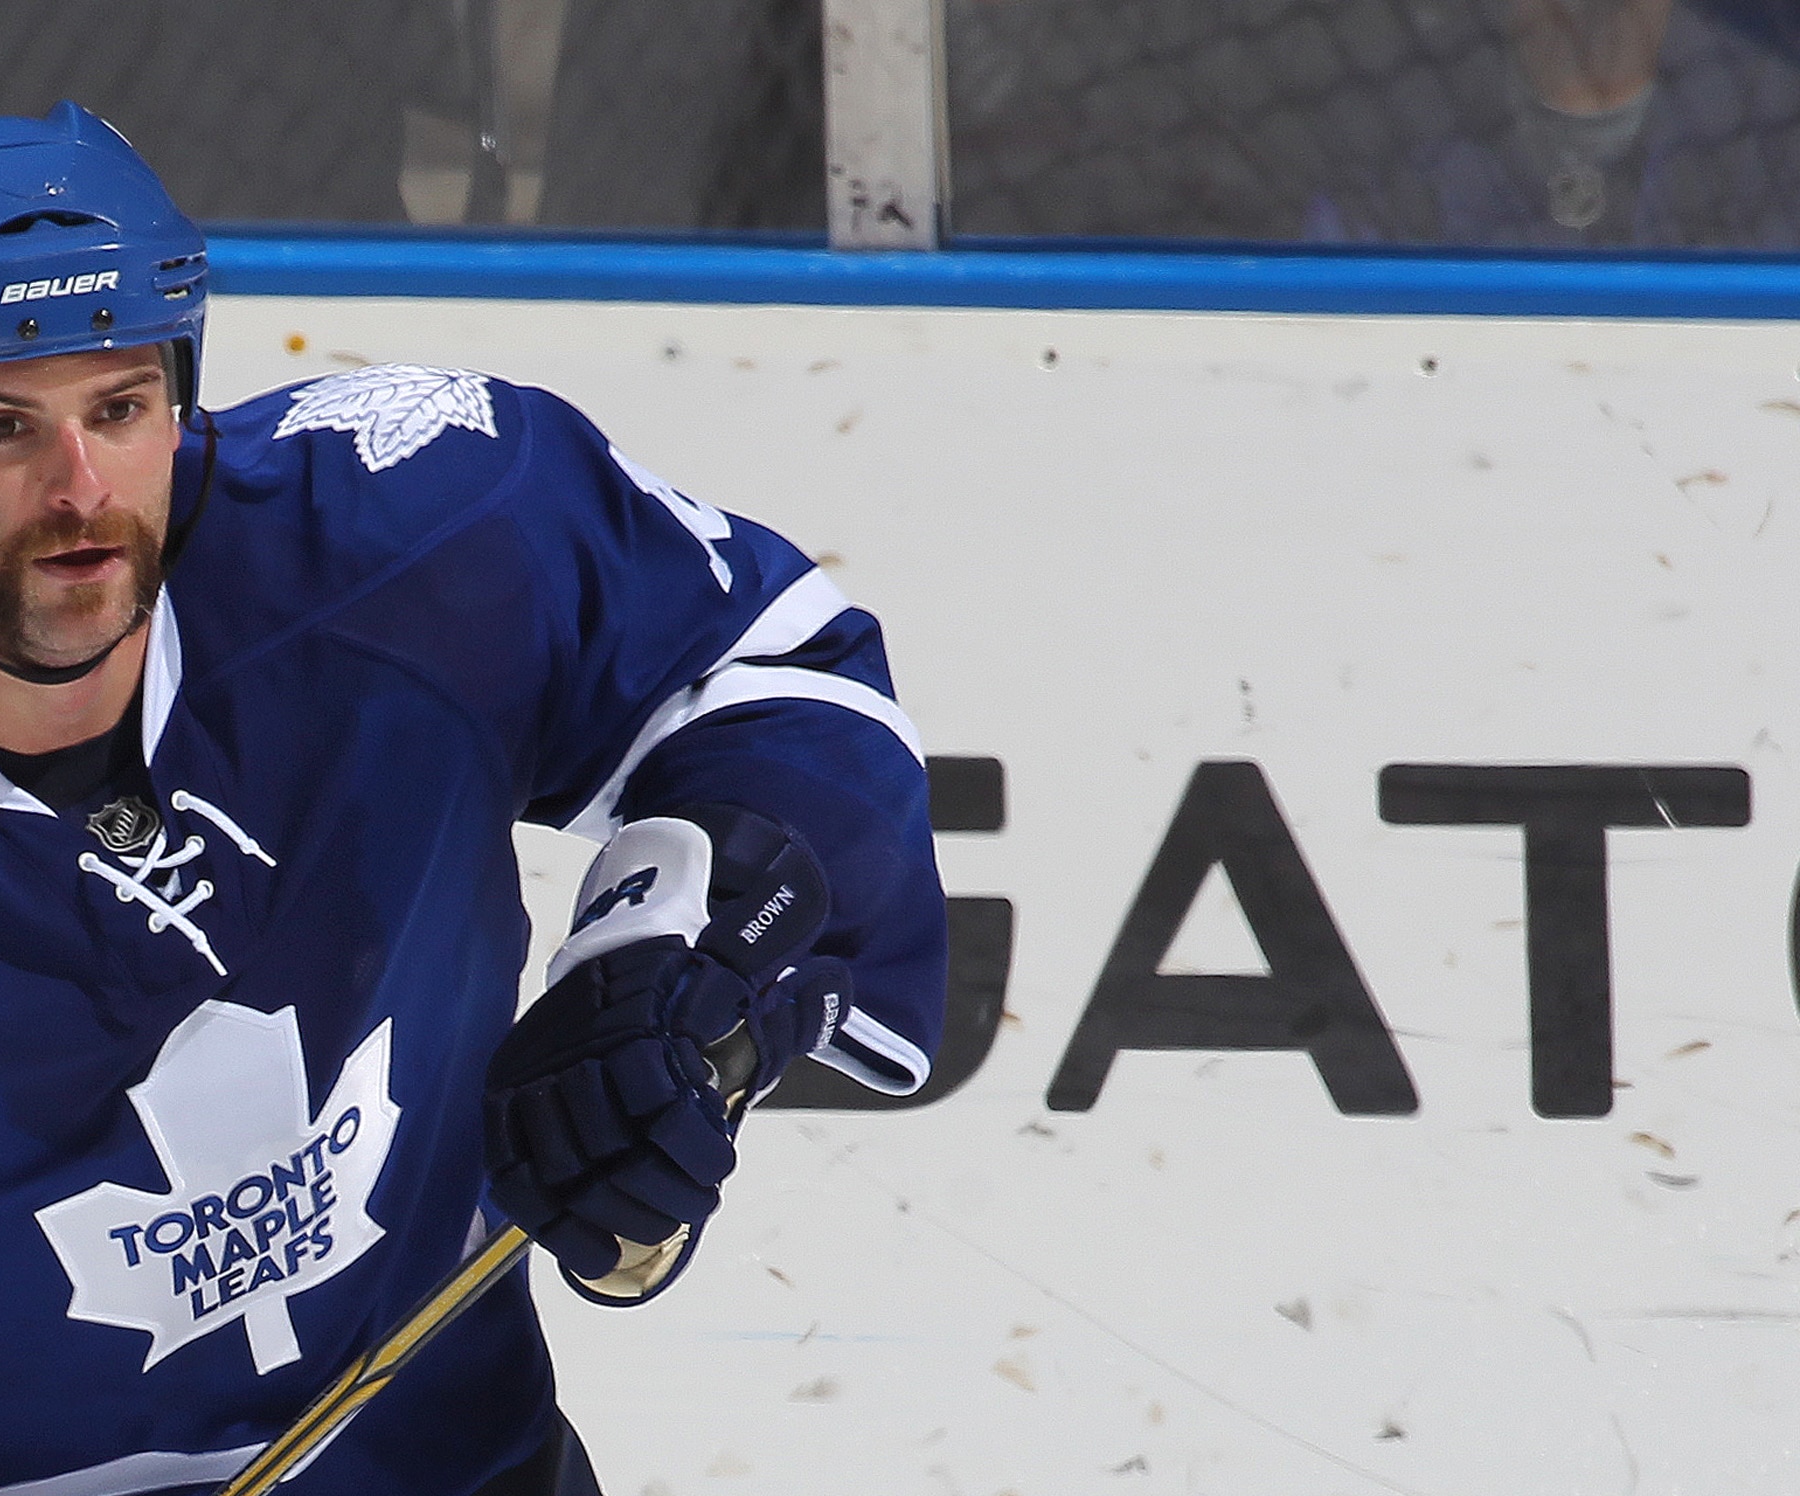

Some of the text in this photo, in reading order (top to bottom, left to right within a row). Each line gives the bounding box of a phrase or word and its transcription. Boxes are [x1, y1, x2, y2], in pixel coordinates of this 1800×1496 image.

[110, 808, 139, 843] NHL
[738, 883, 796, 945] BROWN
[109, 1106, 363, 1268] TORONTO
[172, 1173, 338, 1297] MAPLE
[190, 1217, 335, 1321] LEAFS
